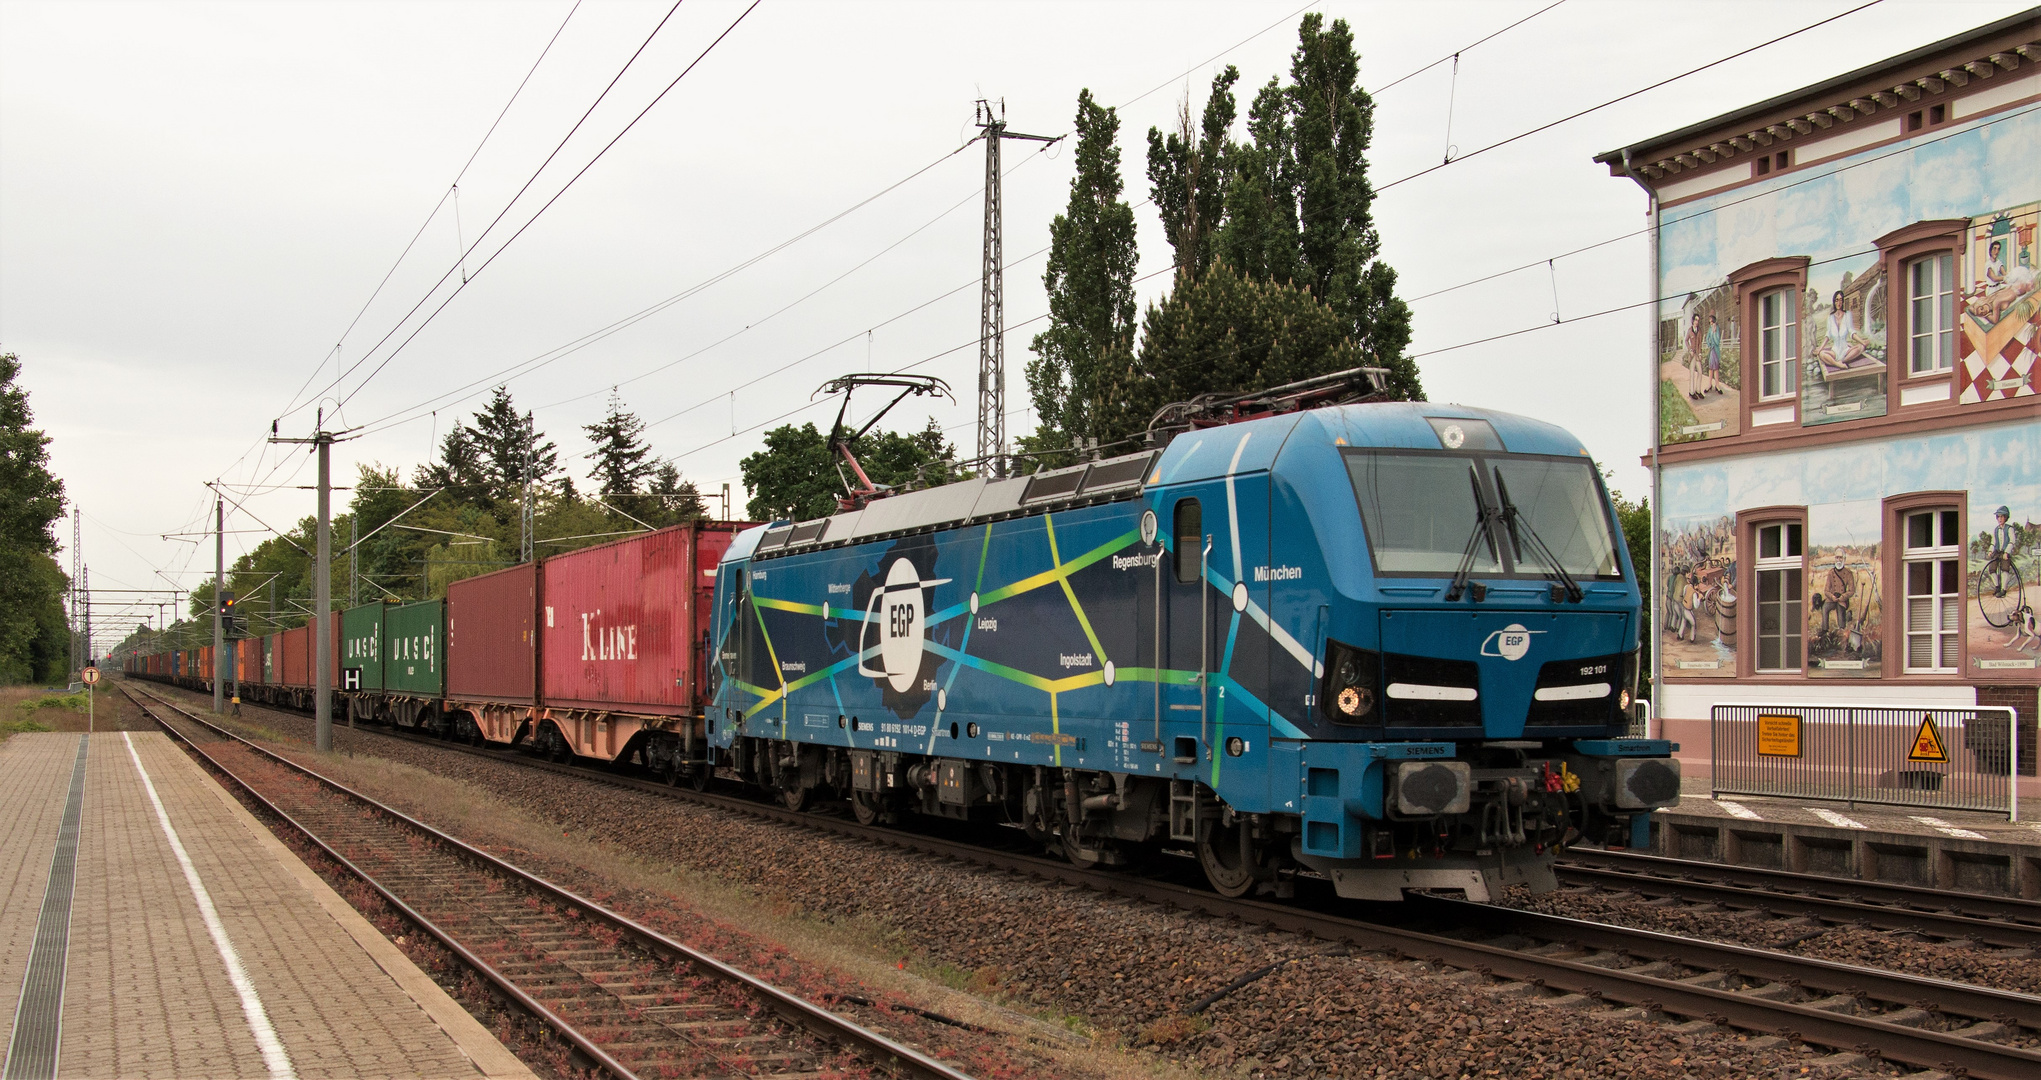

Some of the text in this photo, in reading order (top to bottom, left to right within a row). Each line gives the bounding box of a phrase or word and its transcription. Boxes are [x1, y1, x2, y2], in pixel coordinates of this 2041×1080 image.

[1112, 552, 1157, 569] Regensburg
[1254, 565, 1302, 582] München
[890, 603, 914, 638] EGP
[977, 617, 998, 632] Leipzig
[394, 636, 430, 660] UASC
[1505, 635, 1523, 647] EGP
[781, 661, 806, 673] Braunschweig
[1060, 653, 1092, 669] Ingolstadt
[1580, 665, 1607, 676] 192 101
[345, 670, 360, 690] H
[923, 679, 938, 691] Berlin
[1219, 686, 1225, 698] 2
[1406, 746, 1445, 756] SIEMENS
